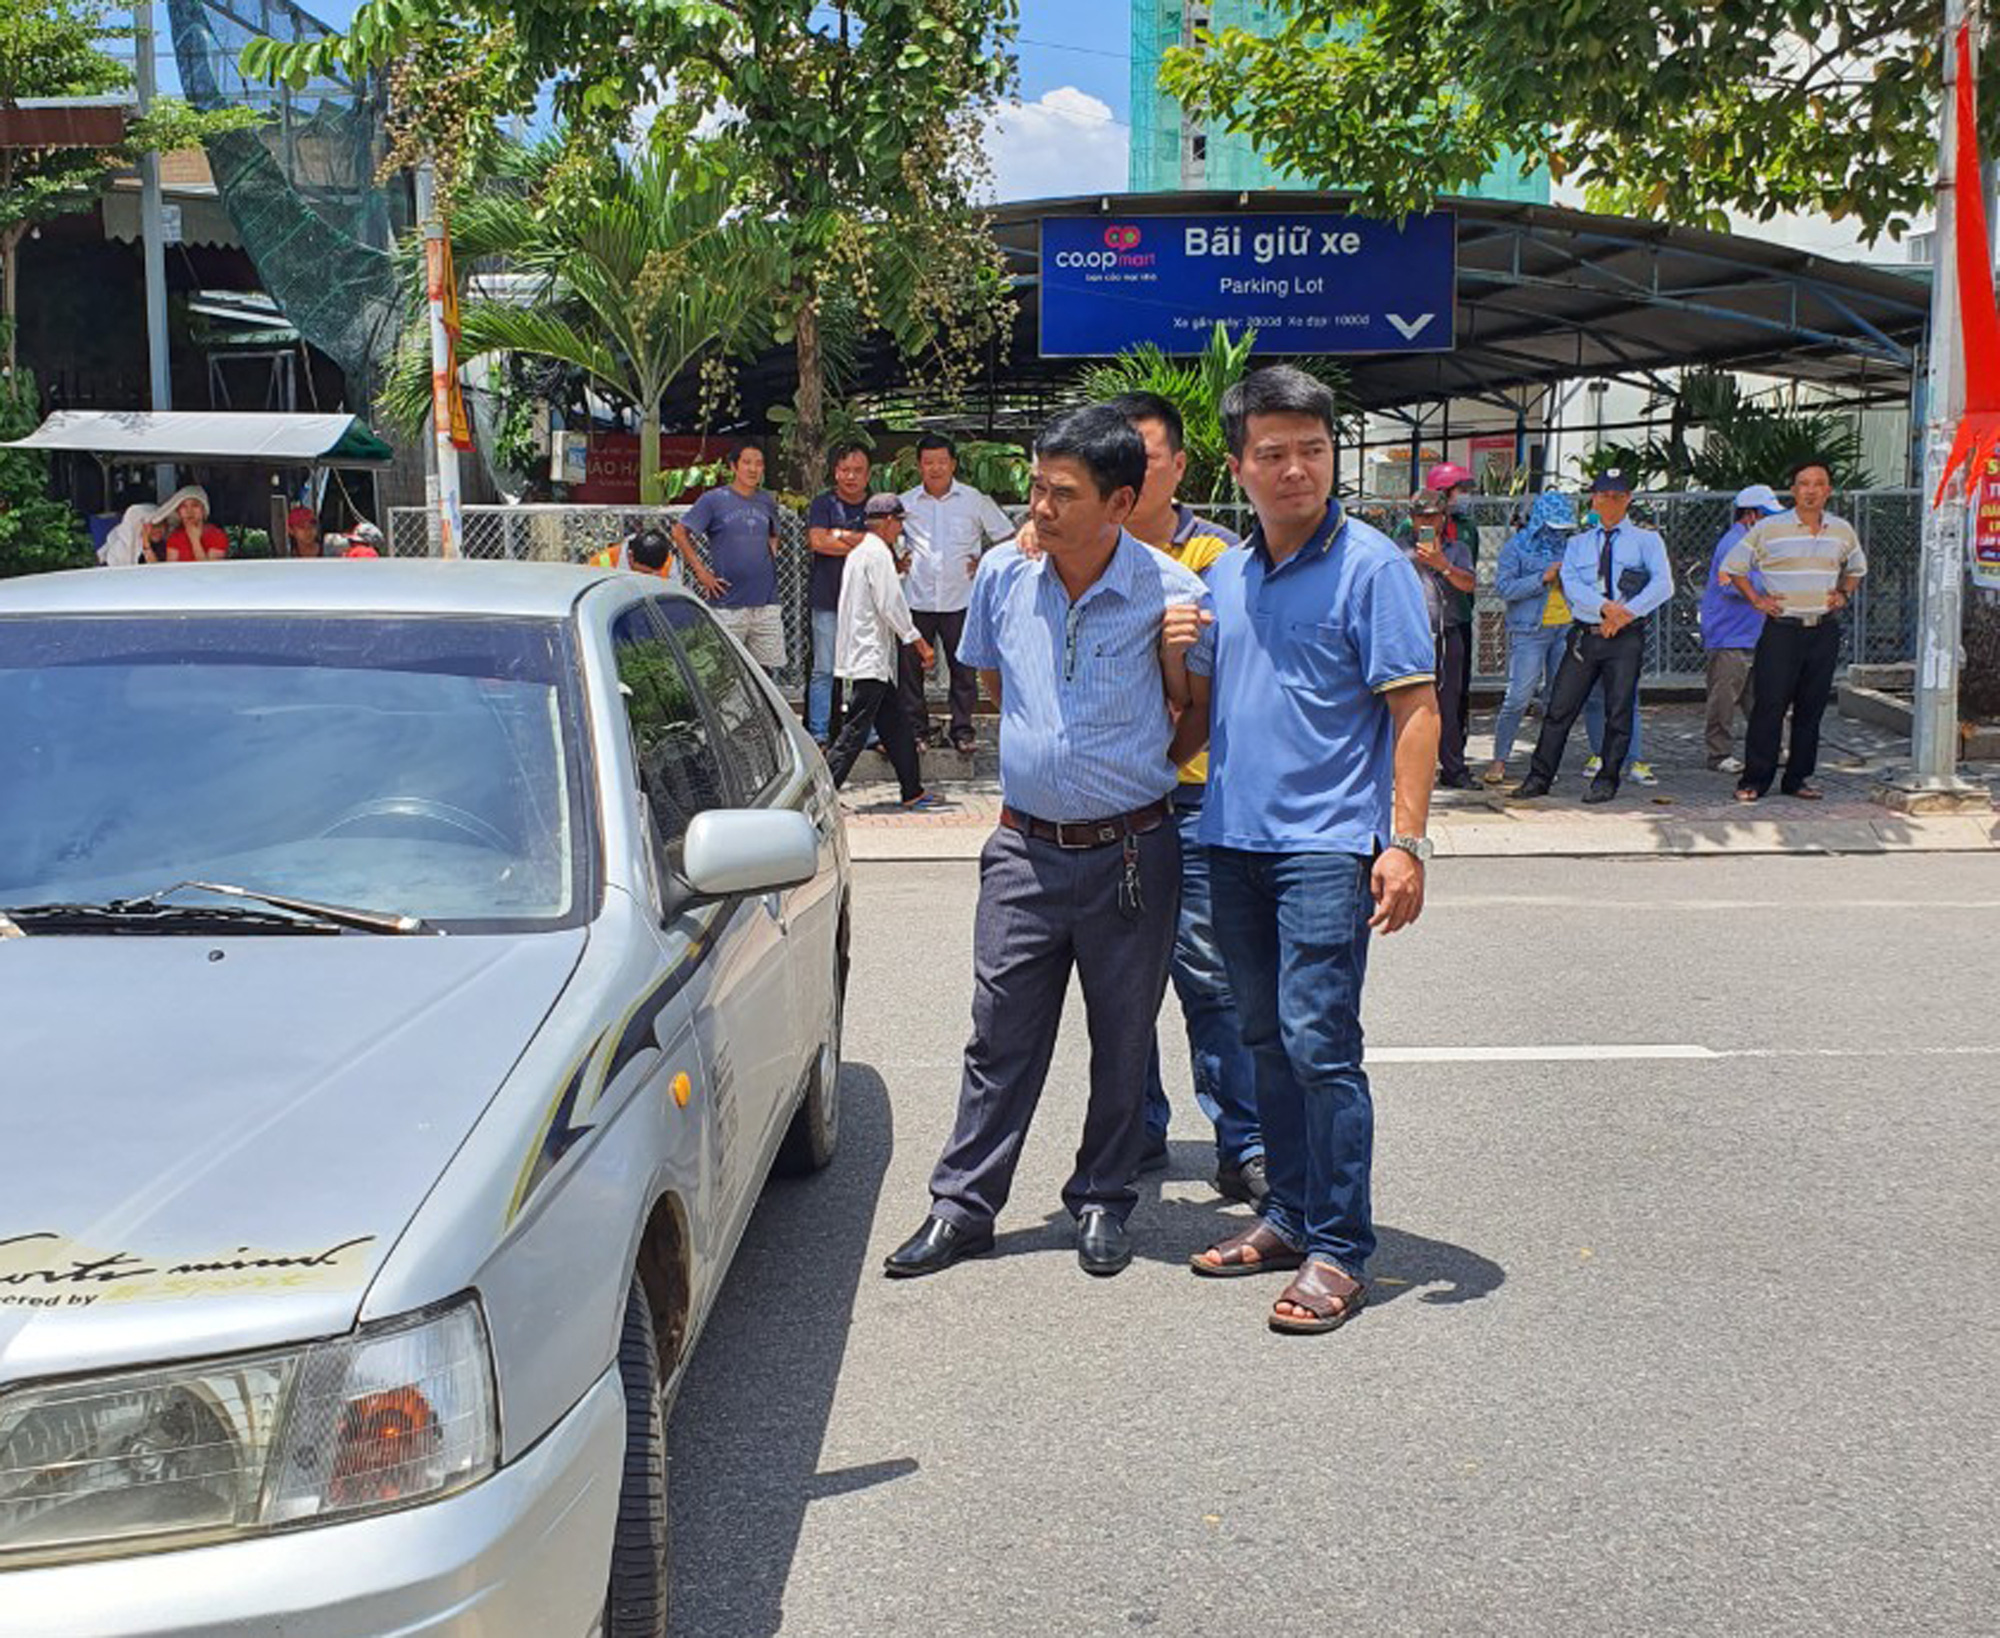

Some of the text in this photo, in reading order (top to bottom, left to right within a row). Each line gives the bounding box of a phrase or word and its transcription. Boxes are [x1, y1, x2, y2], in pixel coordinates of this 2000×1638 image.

[1185, 226, 1361, 263] Bãi giữ xe
[1220, 277, 1324, 298] Parking Lot
[1173, 316, 1188, 329] Xe
[67, 1294, 99, 1306] by
